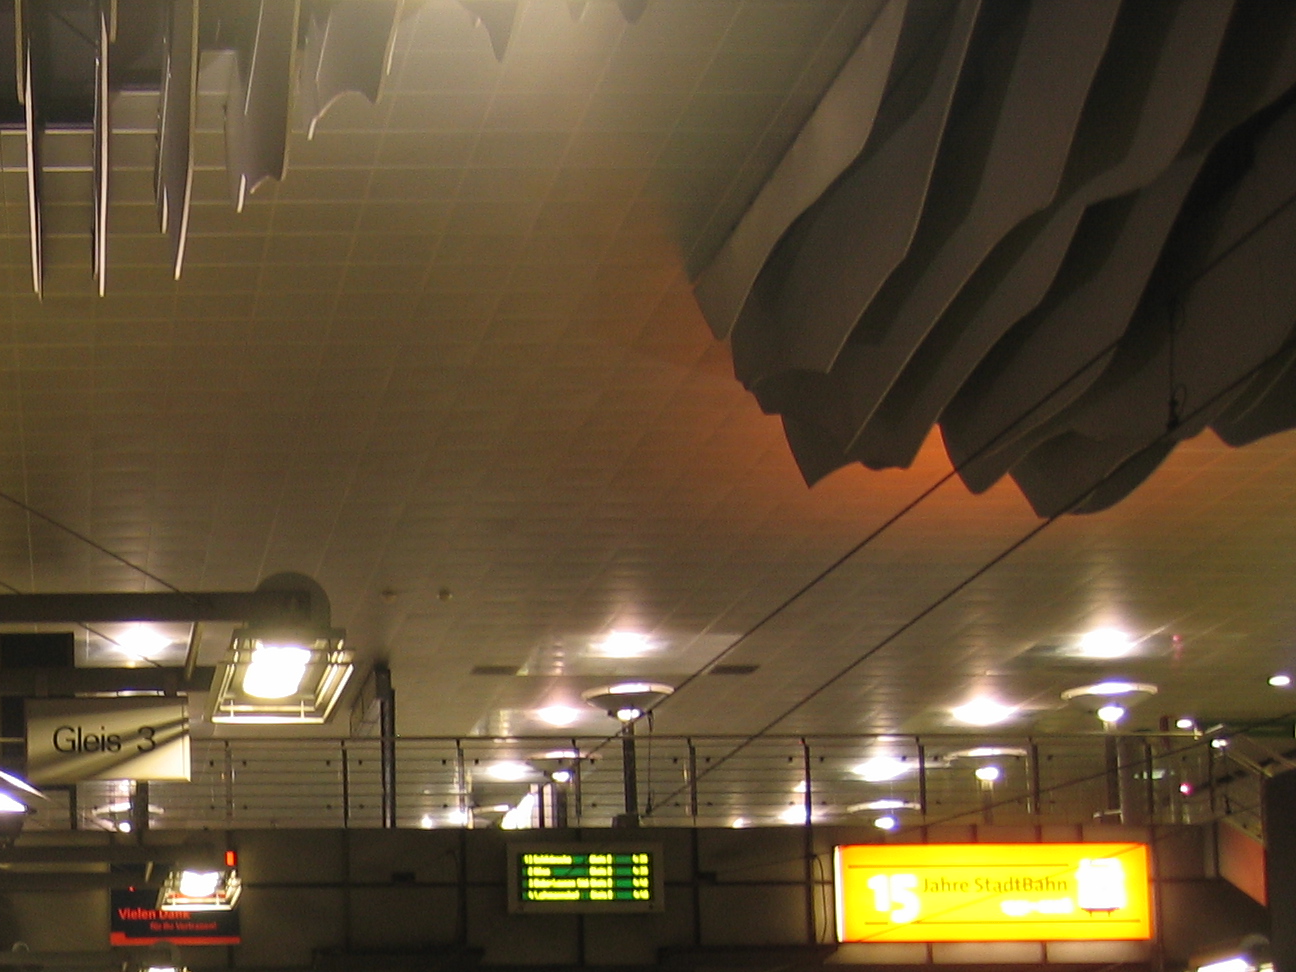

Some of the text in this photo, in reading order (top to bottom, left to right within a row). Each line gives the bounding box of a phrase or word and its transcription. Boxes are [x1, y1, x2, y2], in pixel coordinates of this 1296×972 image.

[53, 725, 156, 753] Gleis 3
[867, 873, 1067, 924] 15 Jahre StadtBahn
[117, 907, 191, 920] Vielen Dank
